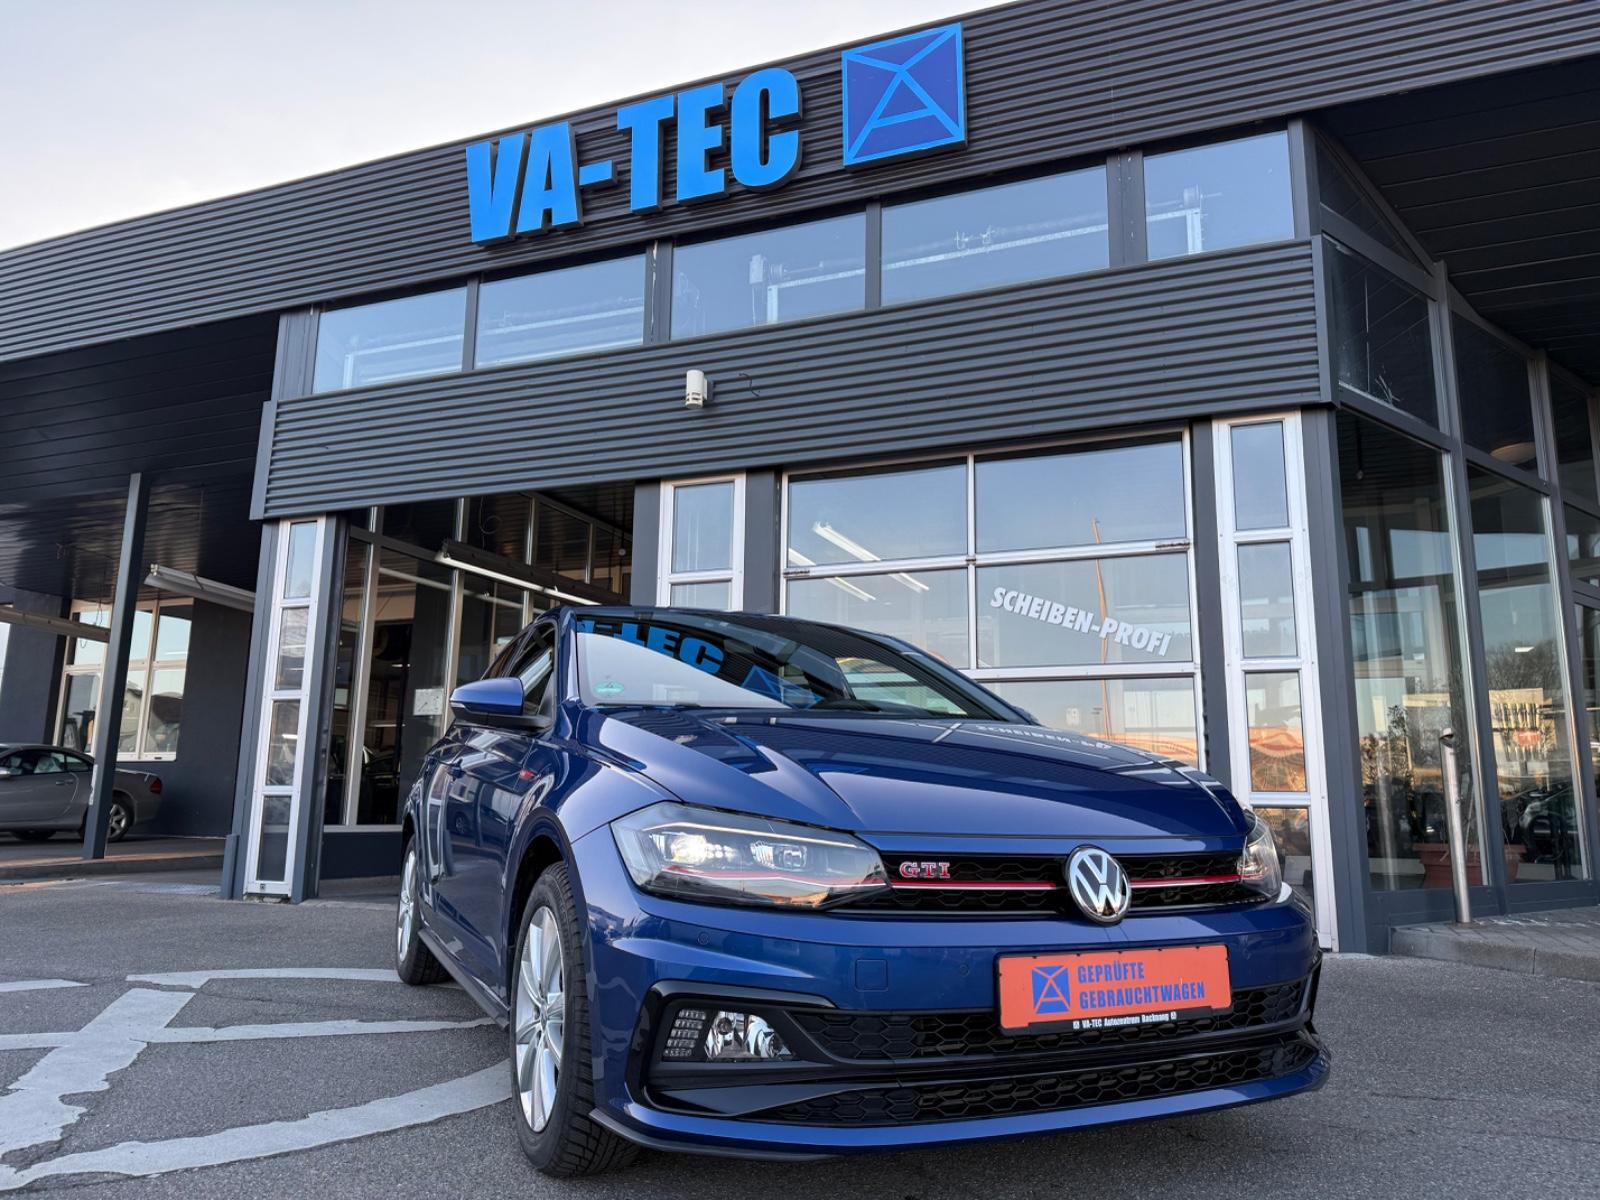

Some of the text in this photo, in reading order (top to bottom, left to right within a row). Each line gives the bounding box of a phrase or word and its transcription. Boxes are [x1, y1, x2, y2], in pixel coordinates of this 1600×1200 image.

[466, 67, 803, 243] VA-TEC
[990, 586, 1172, 657] SCHEIBEN-PROFI
[899, 861, 951, 879] GTI
[1068, 847, 1131, 921] VW
[1077, 960, 1145, 983] GEPRÜFTE
[1079, 982, 1205, 1010] GEBRAUCHTWAGEN
[1081, 1018, 1102, 1029] VA-TEC
